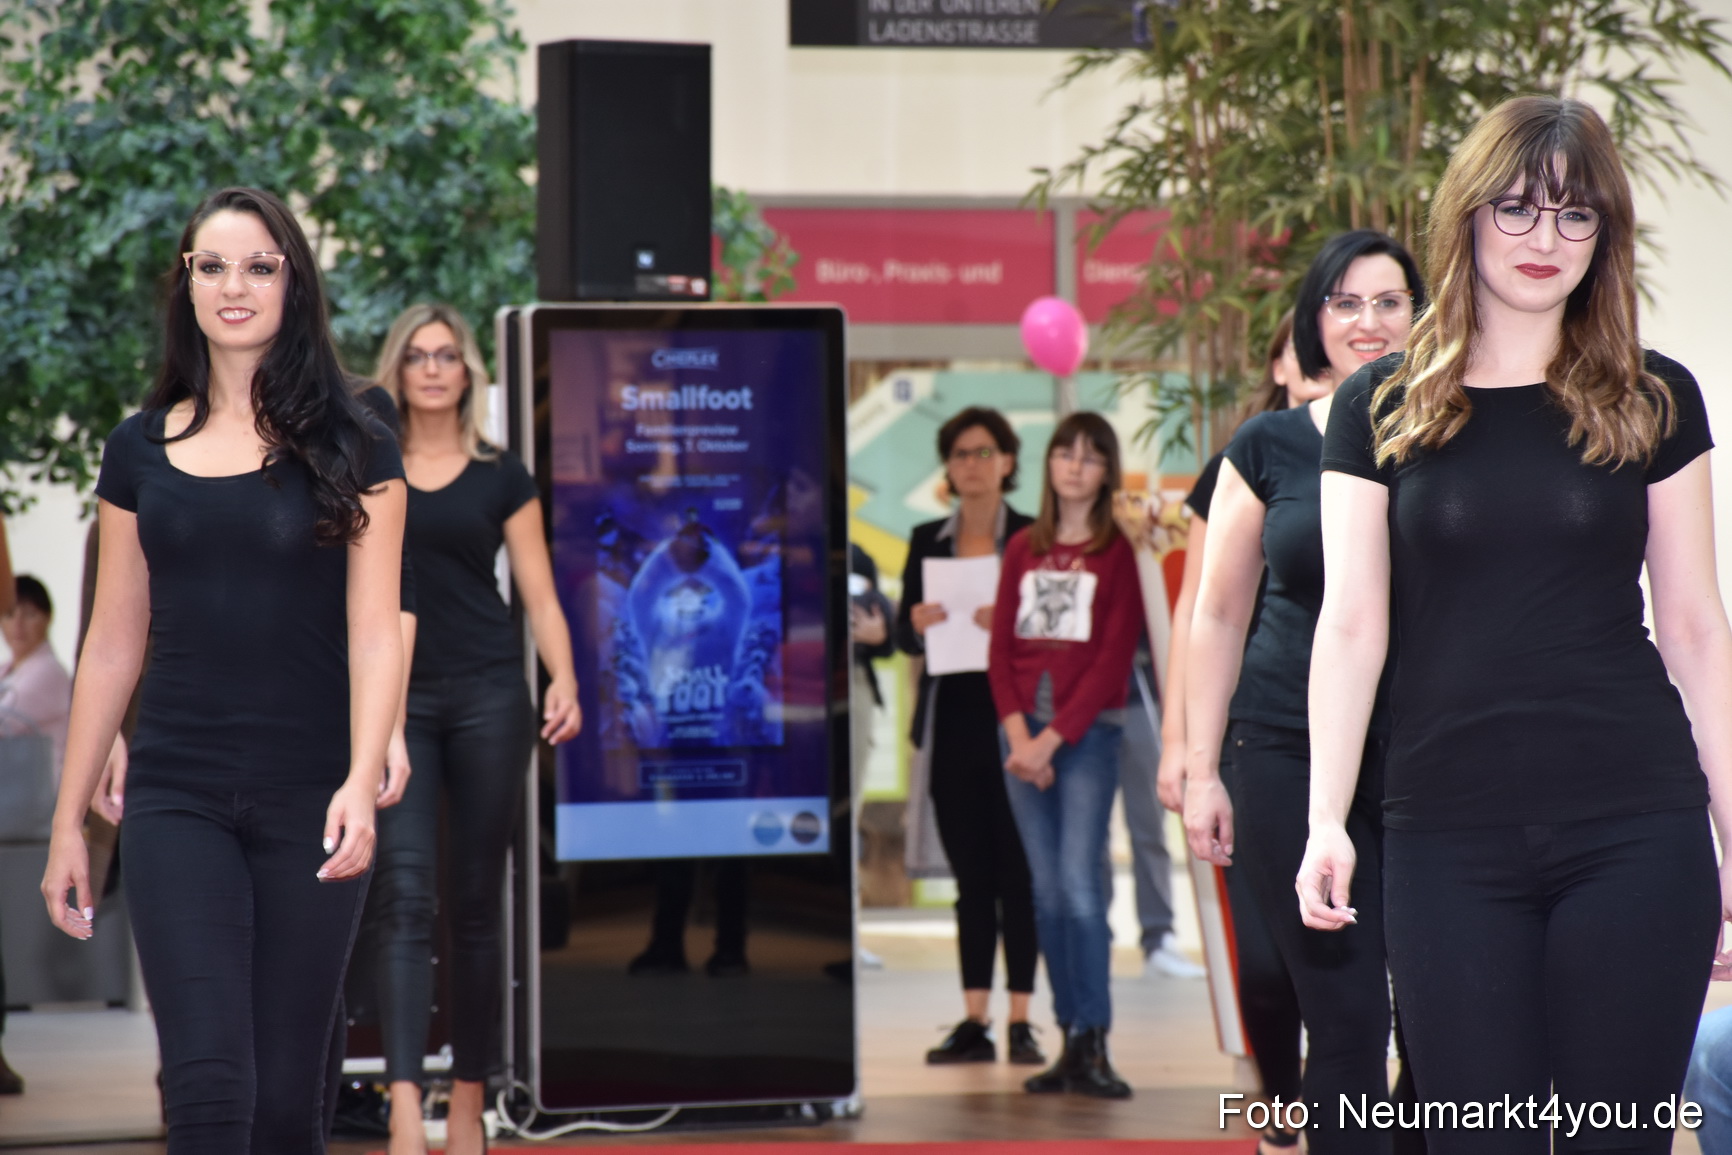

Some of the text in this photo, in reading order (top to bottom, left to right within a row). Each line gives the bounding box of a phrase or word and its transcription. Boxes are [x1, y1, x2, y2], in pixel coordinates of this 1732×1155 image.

[868, 19, 1040, 43] LADENSTRASSE
[957, 258, 1004, 285] und
[621, 385, 753, 411] Smallfoot
